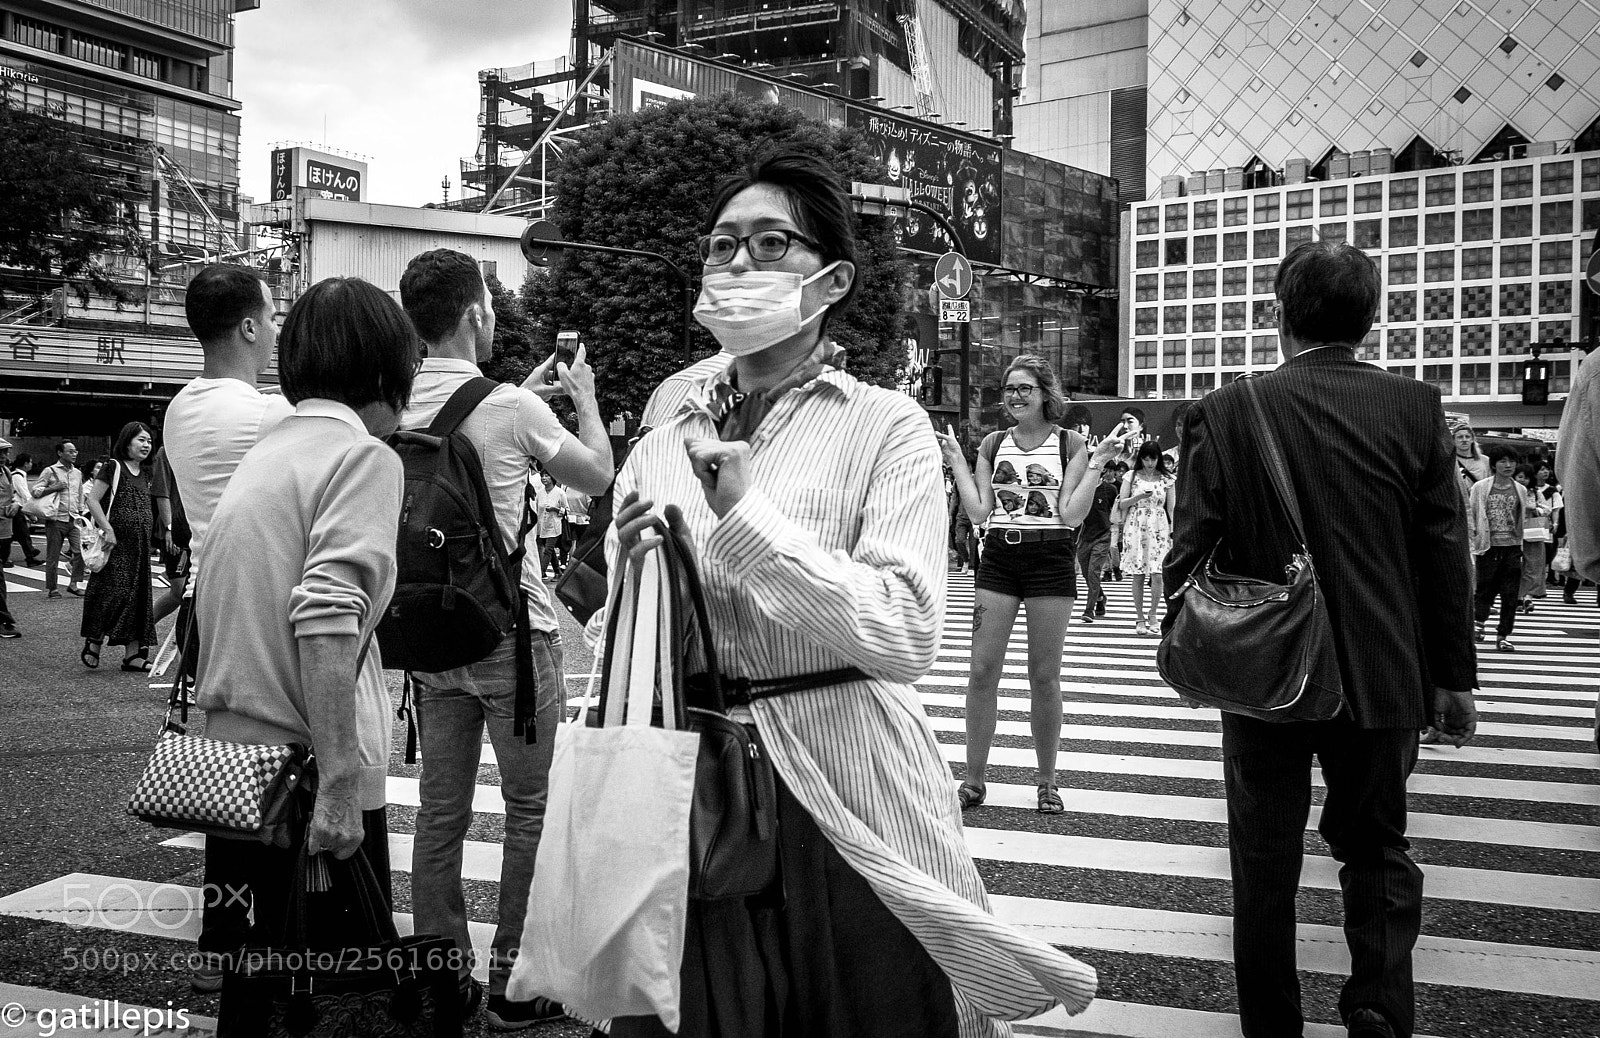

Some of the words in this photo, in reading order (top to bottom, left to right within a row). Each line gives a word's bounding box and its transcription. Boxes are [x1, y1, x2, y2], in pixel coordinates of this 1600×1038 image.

[276, 152, 286, 200] ほけんの
[308, 166, 358, 192] ほけんの
